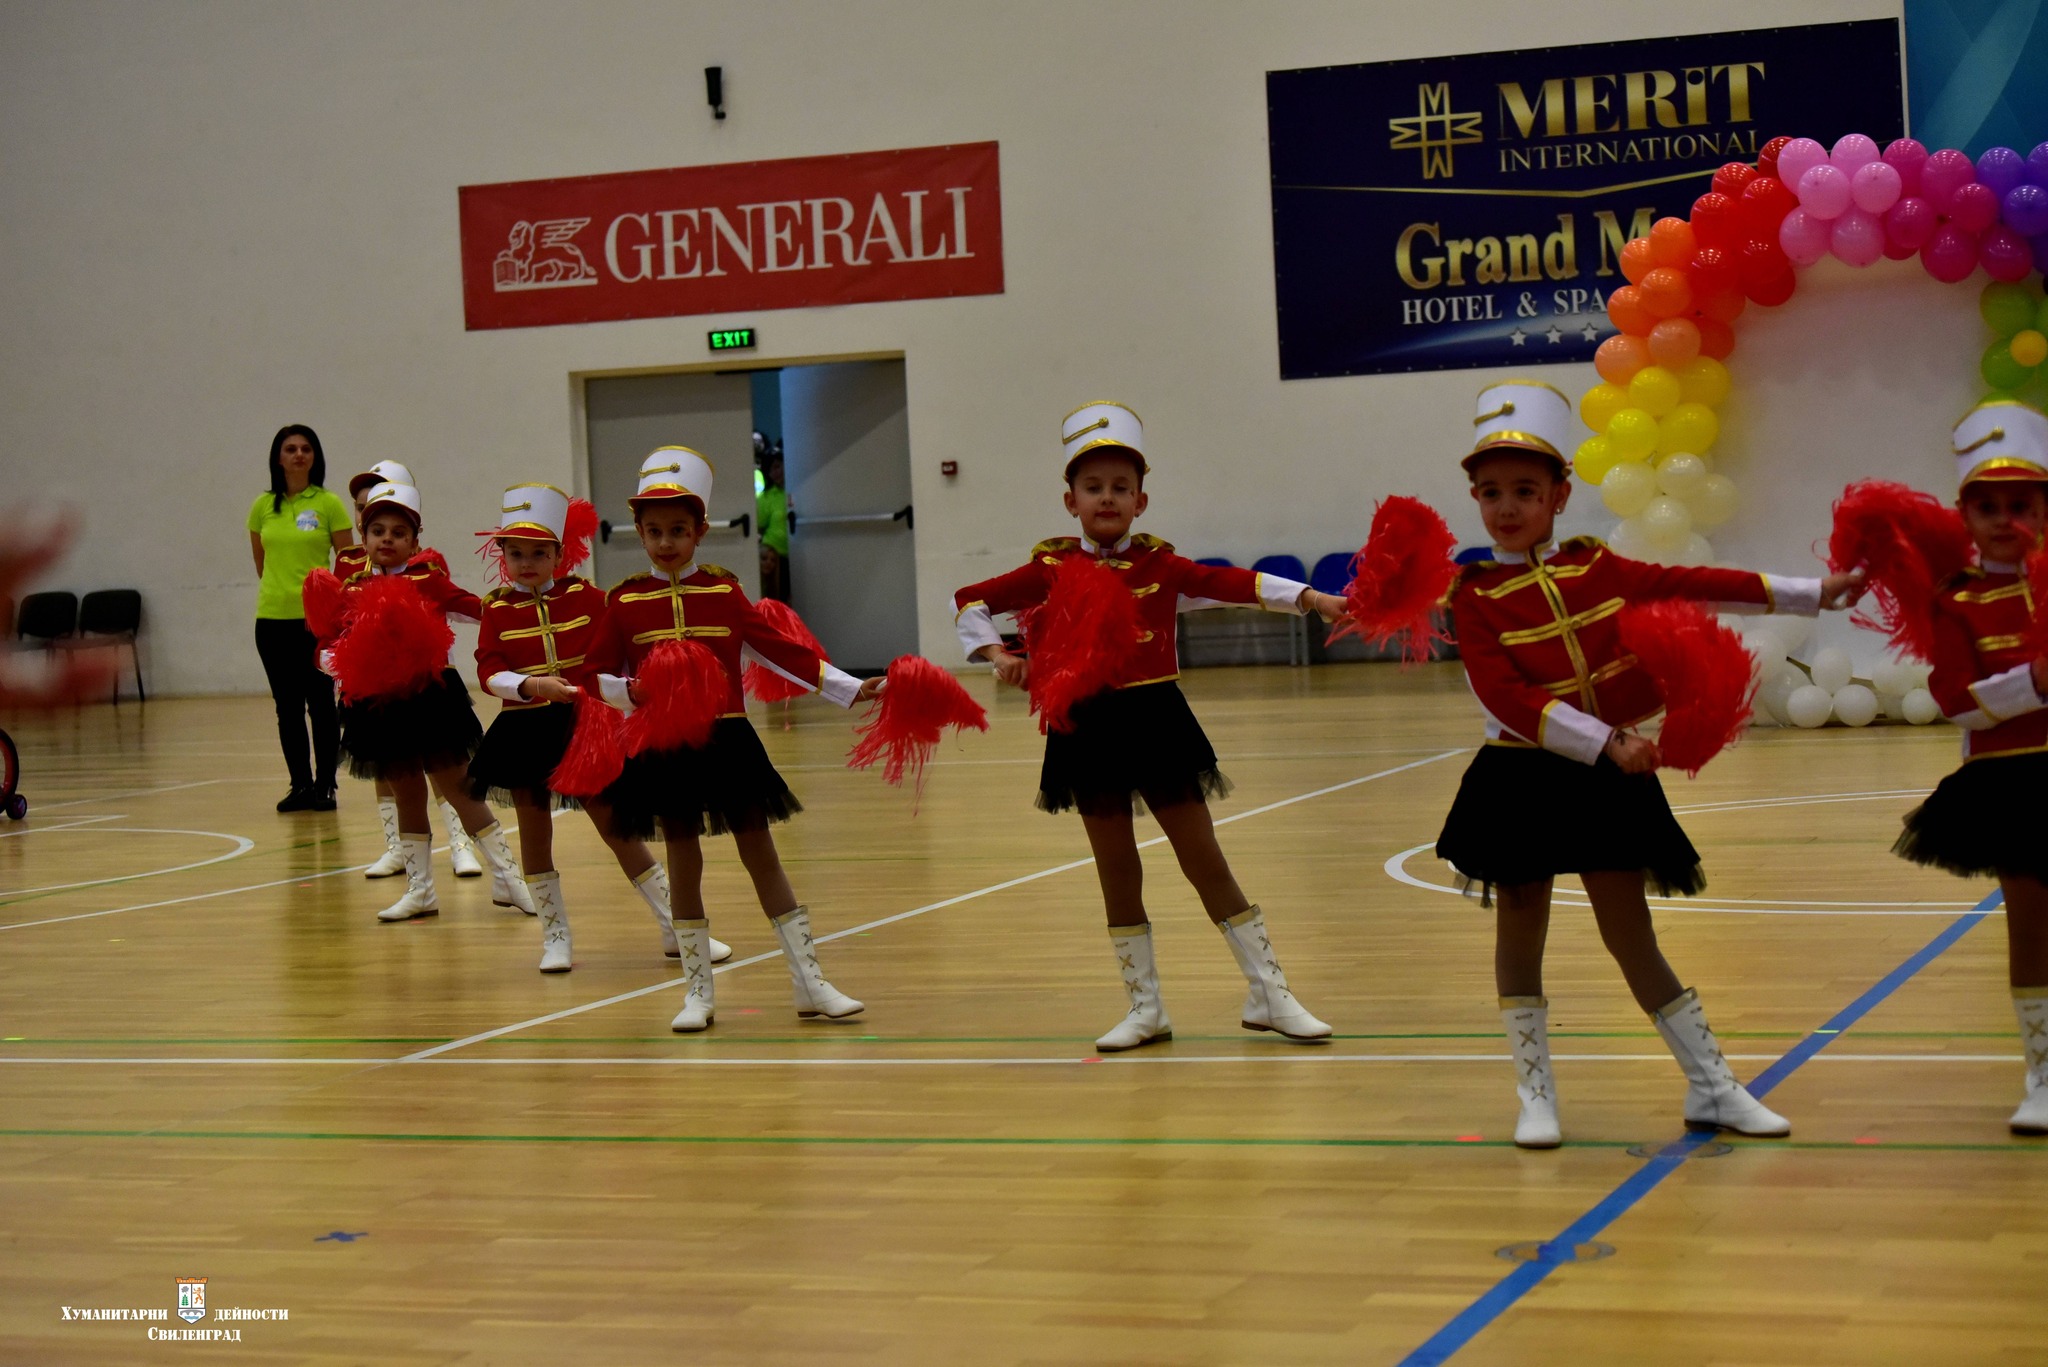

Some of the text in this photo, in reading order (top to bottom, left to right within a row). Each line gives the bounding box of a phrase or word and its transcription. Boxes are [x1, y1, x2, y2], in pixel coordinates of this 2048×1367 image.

[1500, 129, 1761, 174] INTERNATIONAL
[604, 186, 975, 284] GENERALI
[1395, 213, 1579, 290] Grand
[1402, 287, 1607, 325] HOTEL & SPA
[712, 331, 750, 348] EXIT
